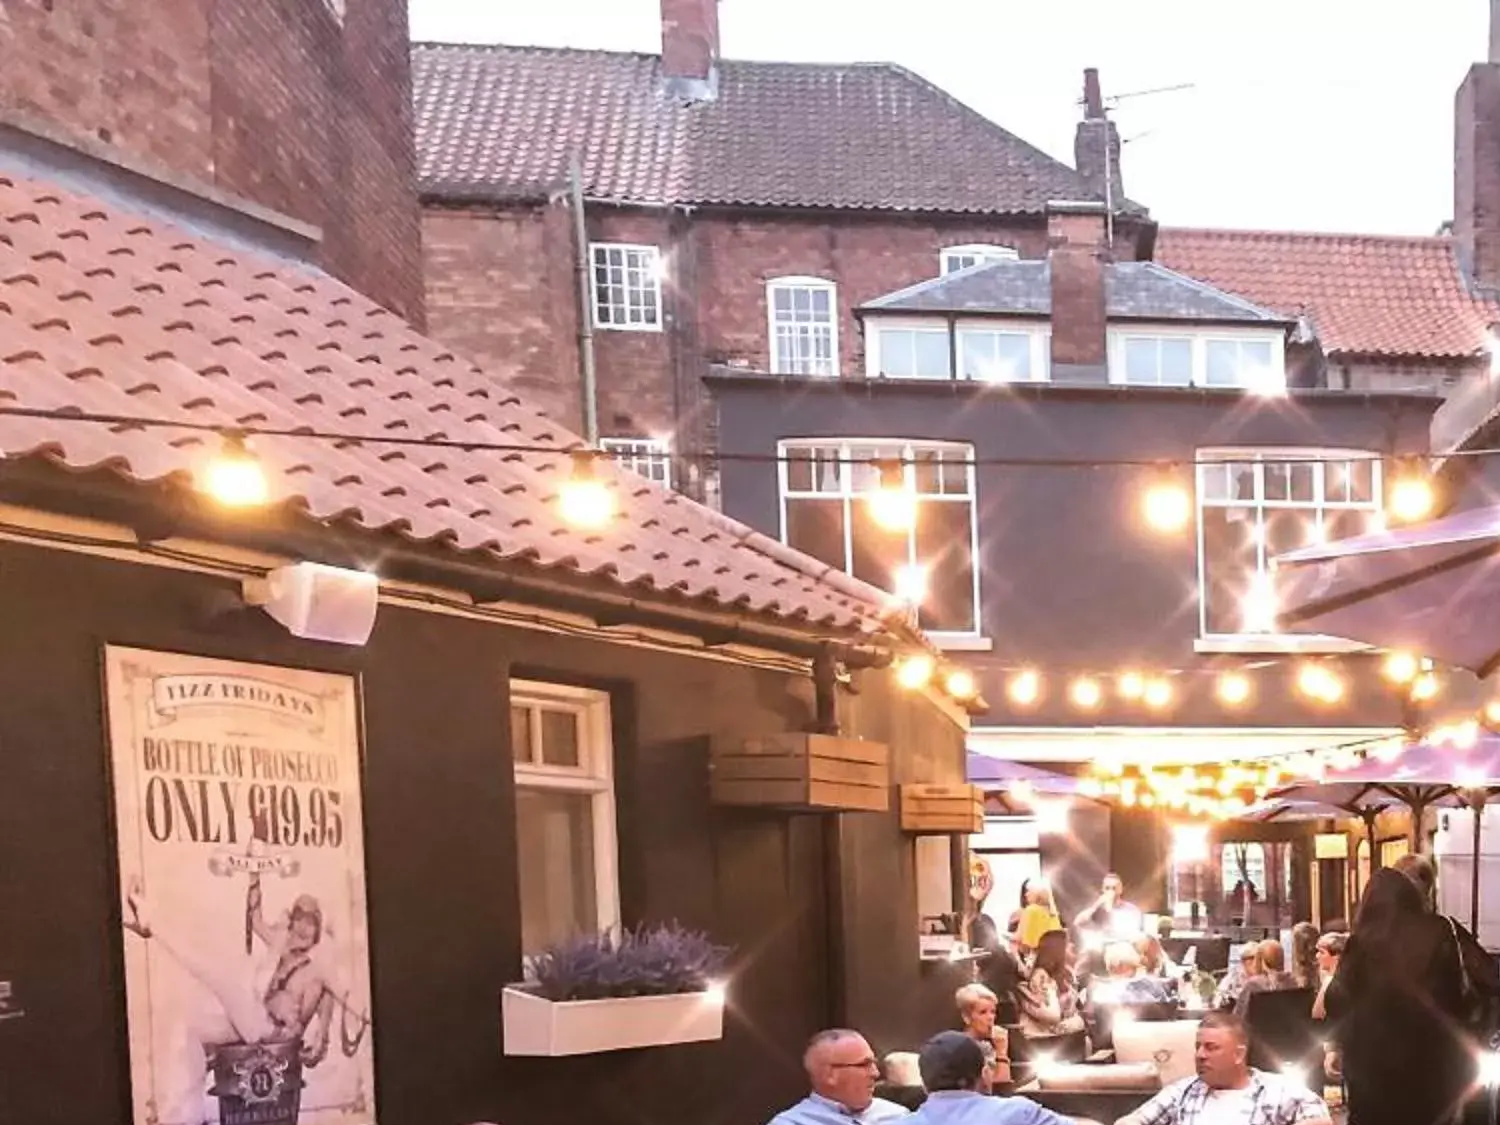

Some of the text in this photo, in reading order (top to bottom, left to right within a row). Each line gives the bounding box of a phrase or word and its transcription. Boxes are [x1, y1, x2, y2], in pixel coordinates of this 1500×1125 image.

[167, 683, 314, 715] FIZZ FRIDAYS
[143, 737, 338, 784] BOTTLE OF PROSECCO
[145, 775, 343, 848] ONLY £19.95
